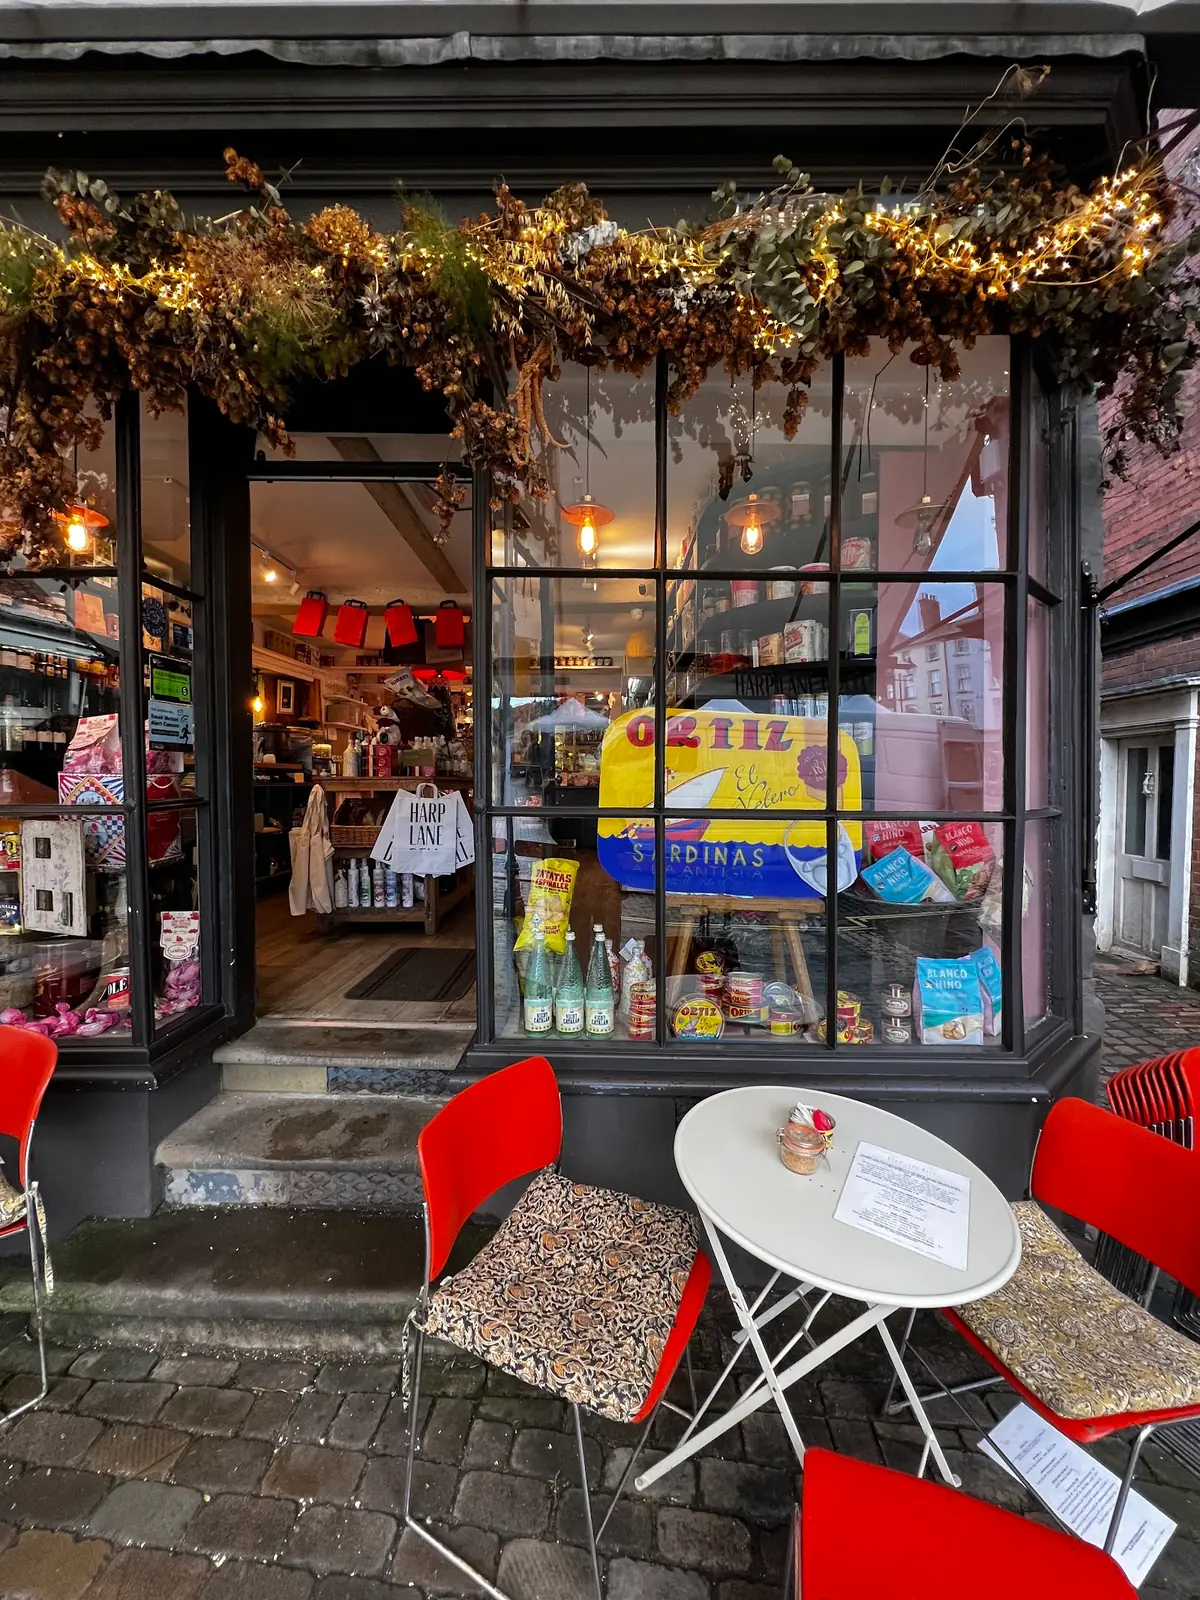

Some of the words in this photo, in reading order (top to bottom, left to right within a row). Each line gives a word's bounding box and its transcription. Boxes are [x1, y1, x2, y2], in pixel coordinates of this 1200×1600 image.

[626, 715, 795, 752] ORTIZ
[734, 764, 759, 792] El
[733, 781, 800, 809] Velero
[409, 802, 446, 823] HARP
[409, 825, 444, 846] LANE
[944, 824, 973, 841] BLANCO
[632, 842, 765, 868] SRDINAS
[536, 869, 572, 883] PATATAS
[873, 857, 906, 881] BLANCO
[927, 968, 968, 979] BLANCO
[680, 1007, 717, 1016] ORTIZ
